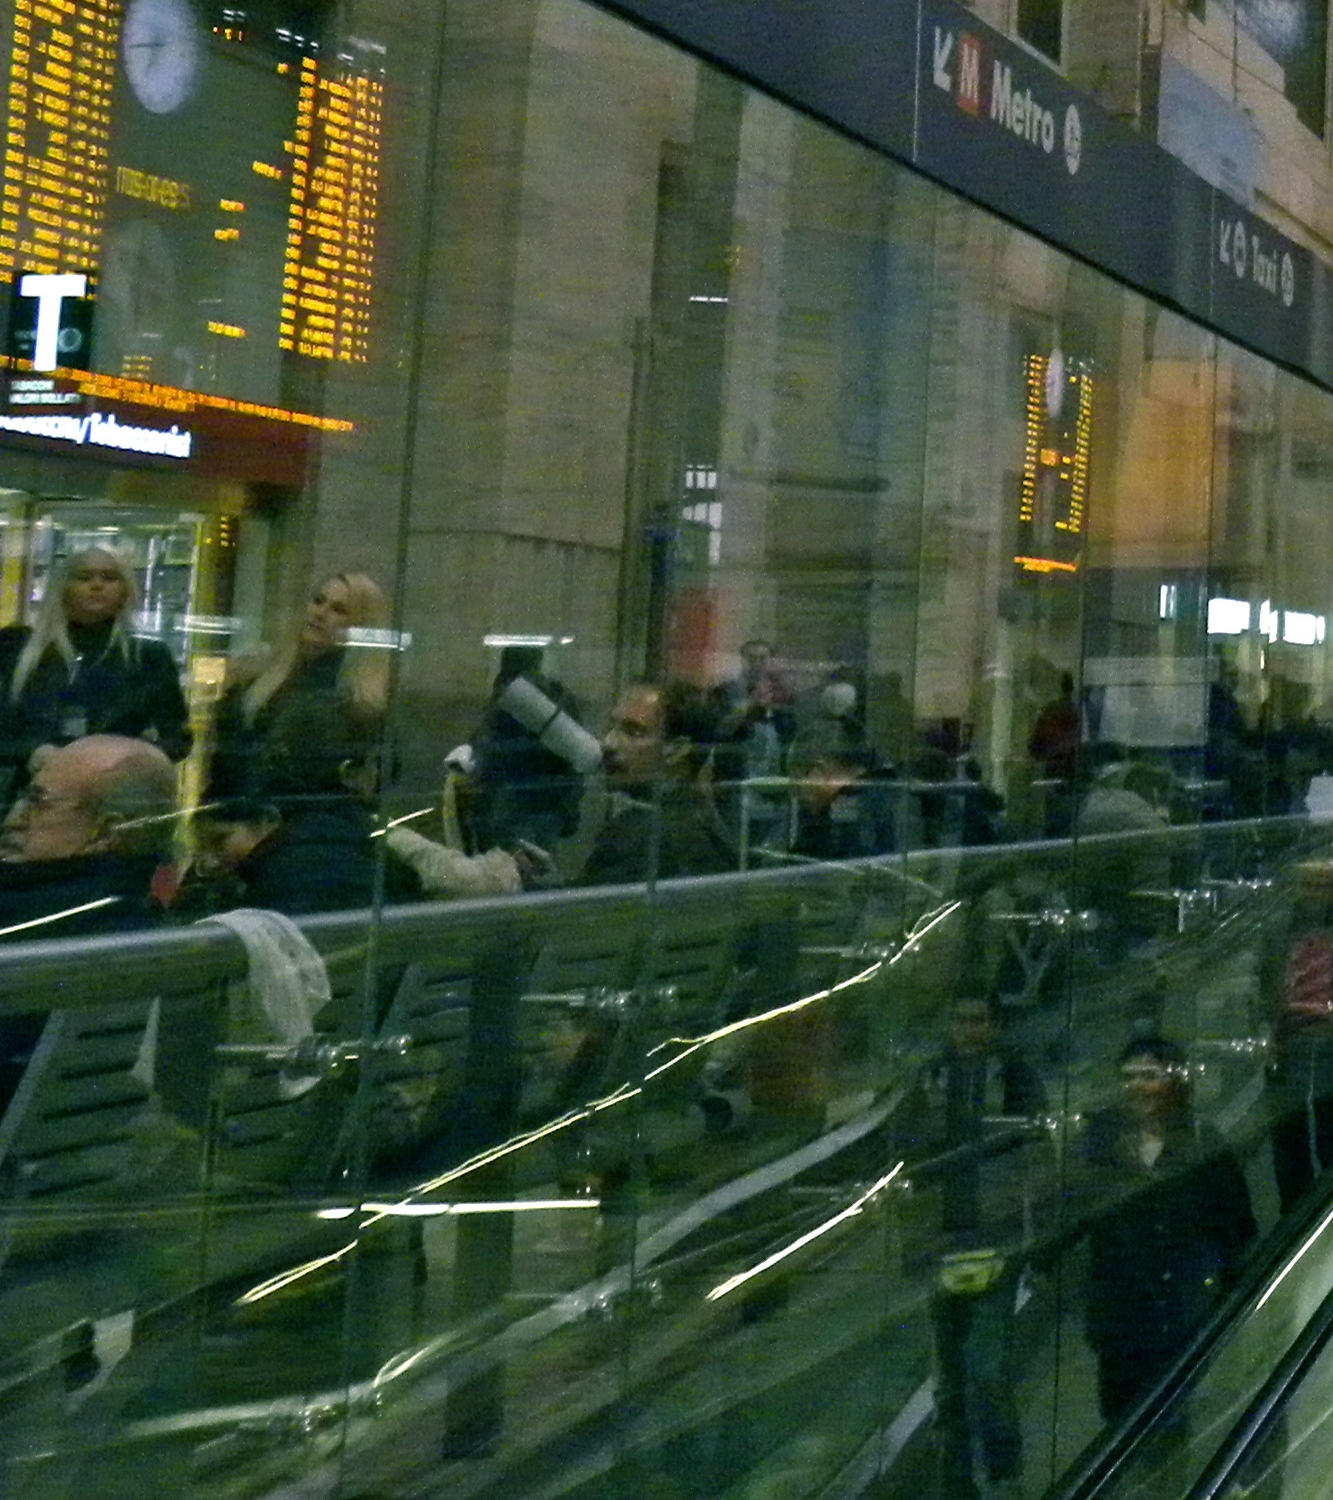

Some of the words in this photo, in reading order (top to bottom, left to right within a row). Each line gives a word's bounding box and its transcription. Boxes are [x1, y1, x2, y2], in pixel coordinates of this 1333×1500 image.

[960, 43, 979, 103] M
[990, 59, 1055, 154] Metro
[1252, 235, 1277, 295] Taxi
[20, 274, 87, 371] T
